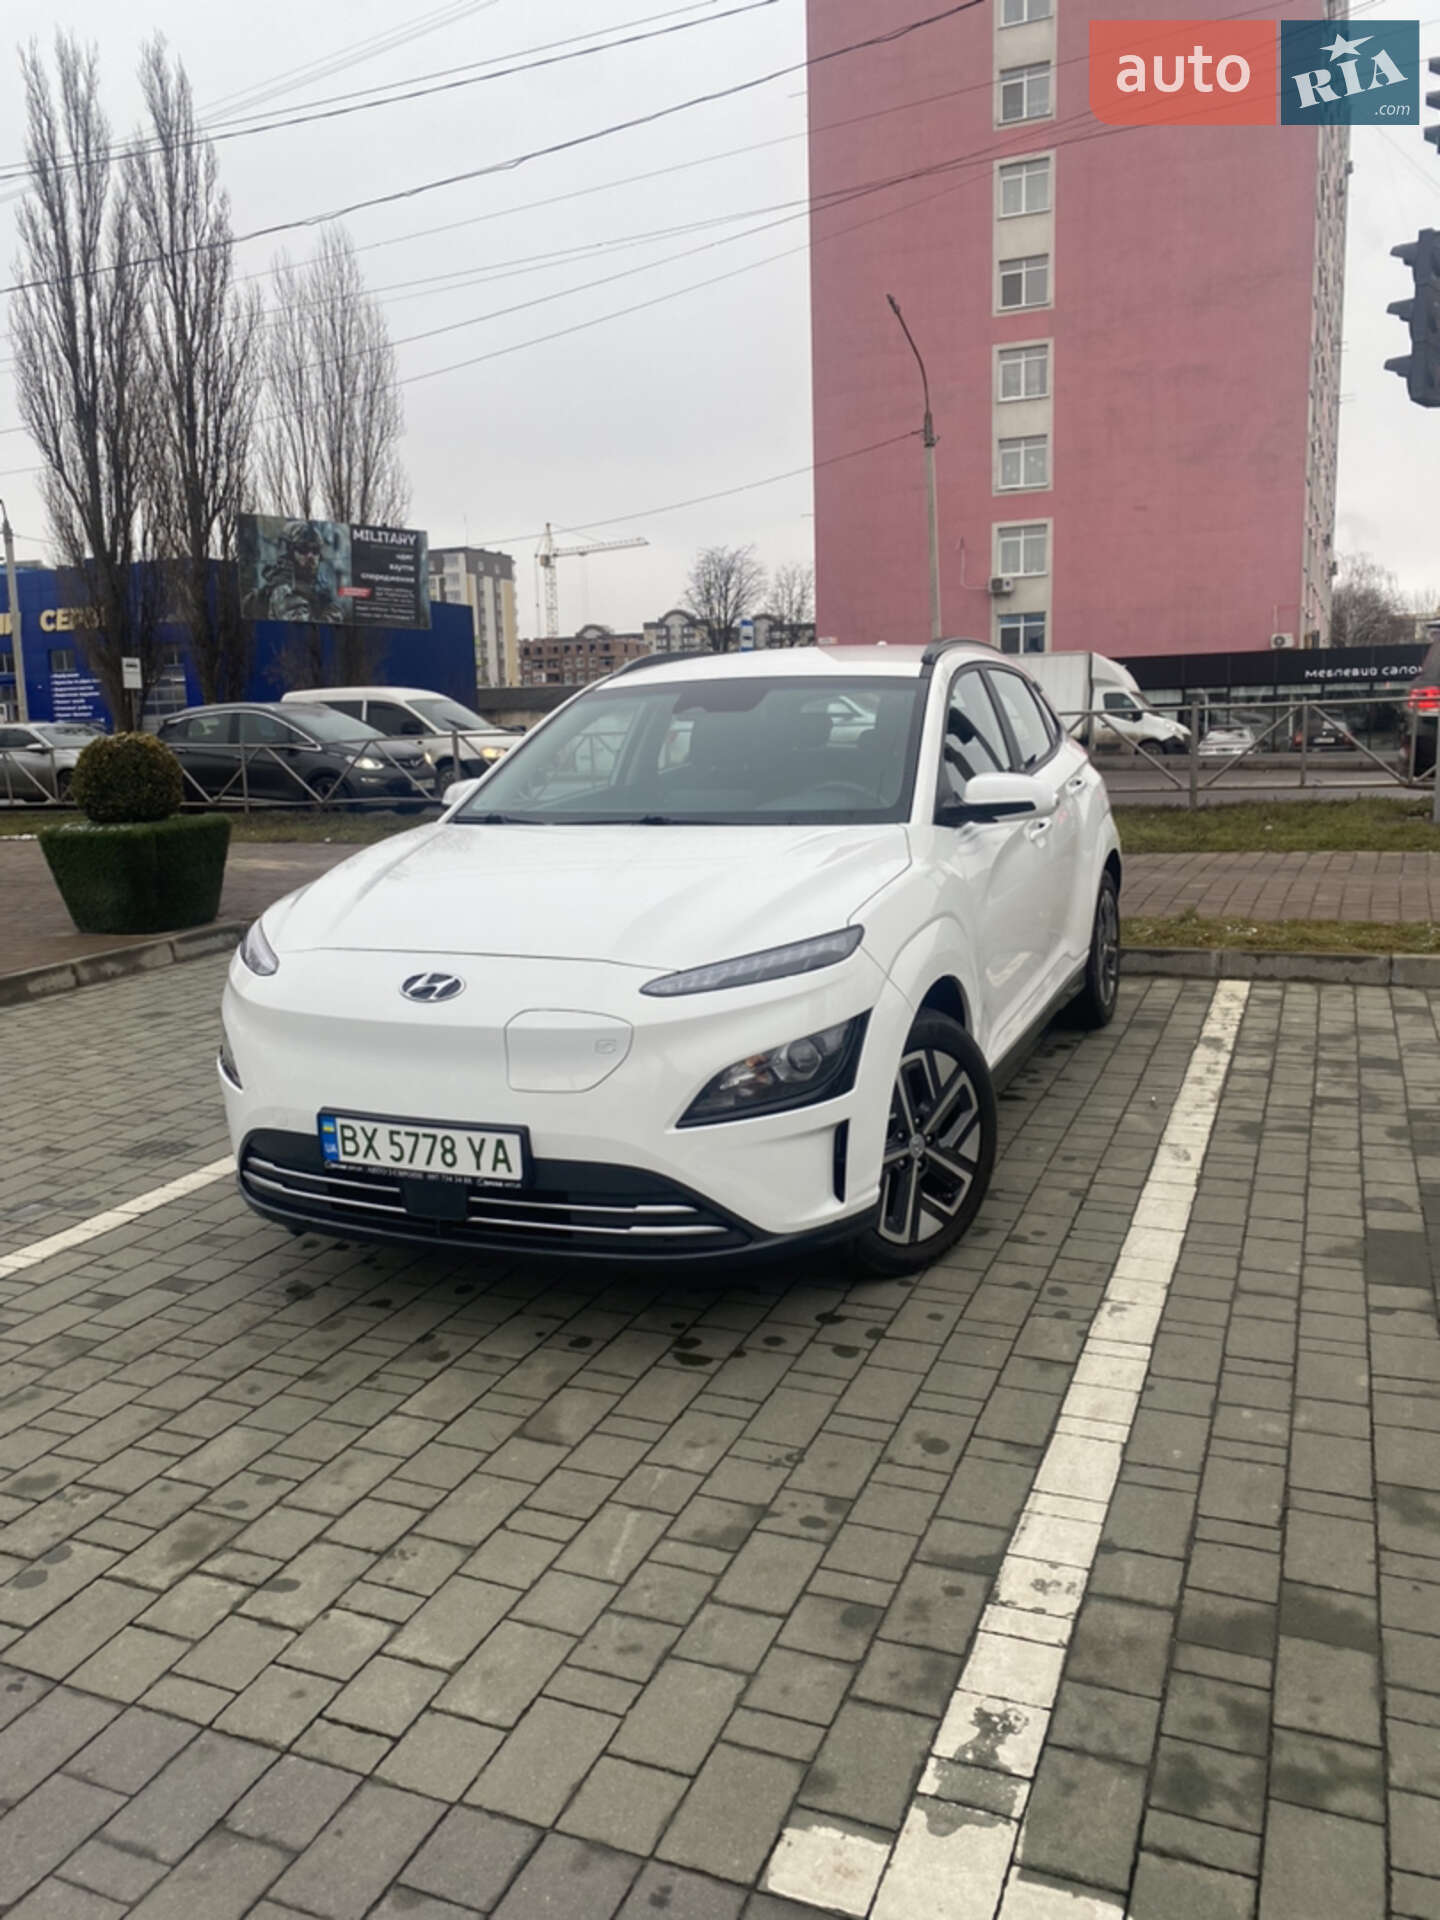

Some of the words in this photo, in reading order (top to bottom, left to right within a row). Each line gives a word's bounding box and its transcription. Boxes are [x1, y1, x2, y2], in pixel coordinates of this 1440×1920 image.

[352, 529, 416, 545] MILITARY
[339, 1124, 381, 1160] BX
[389, 1130, 457, 1168] 5778
[467, 1136, 513, 1173] YA
